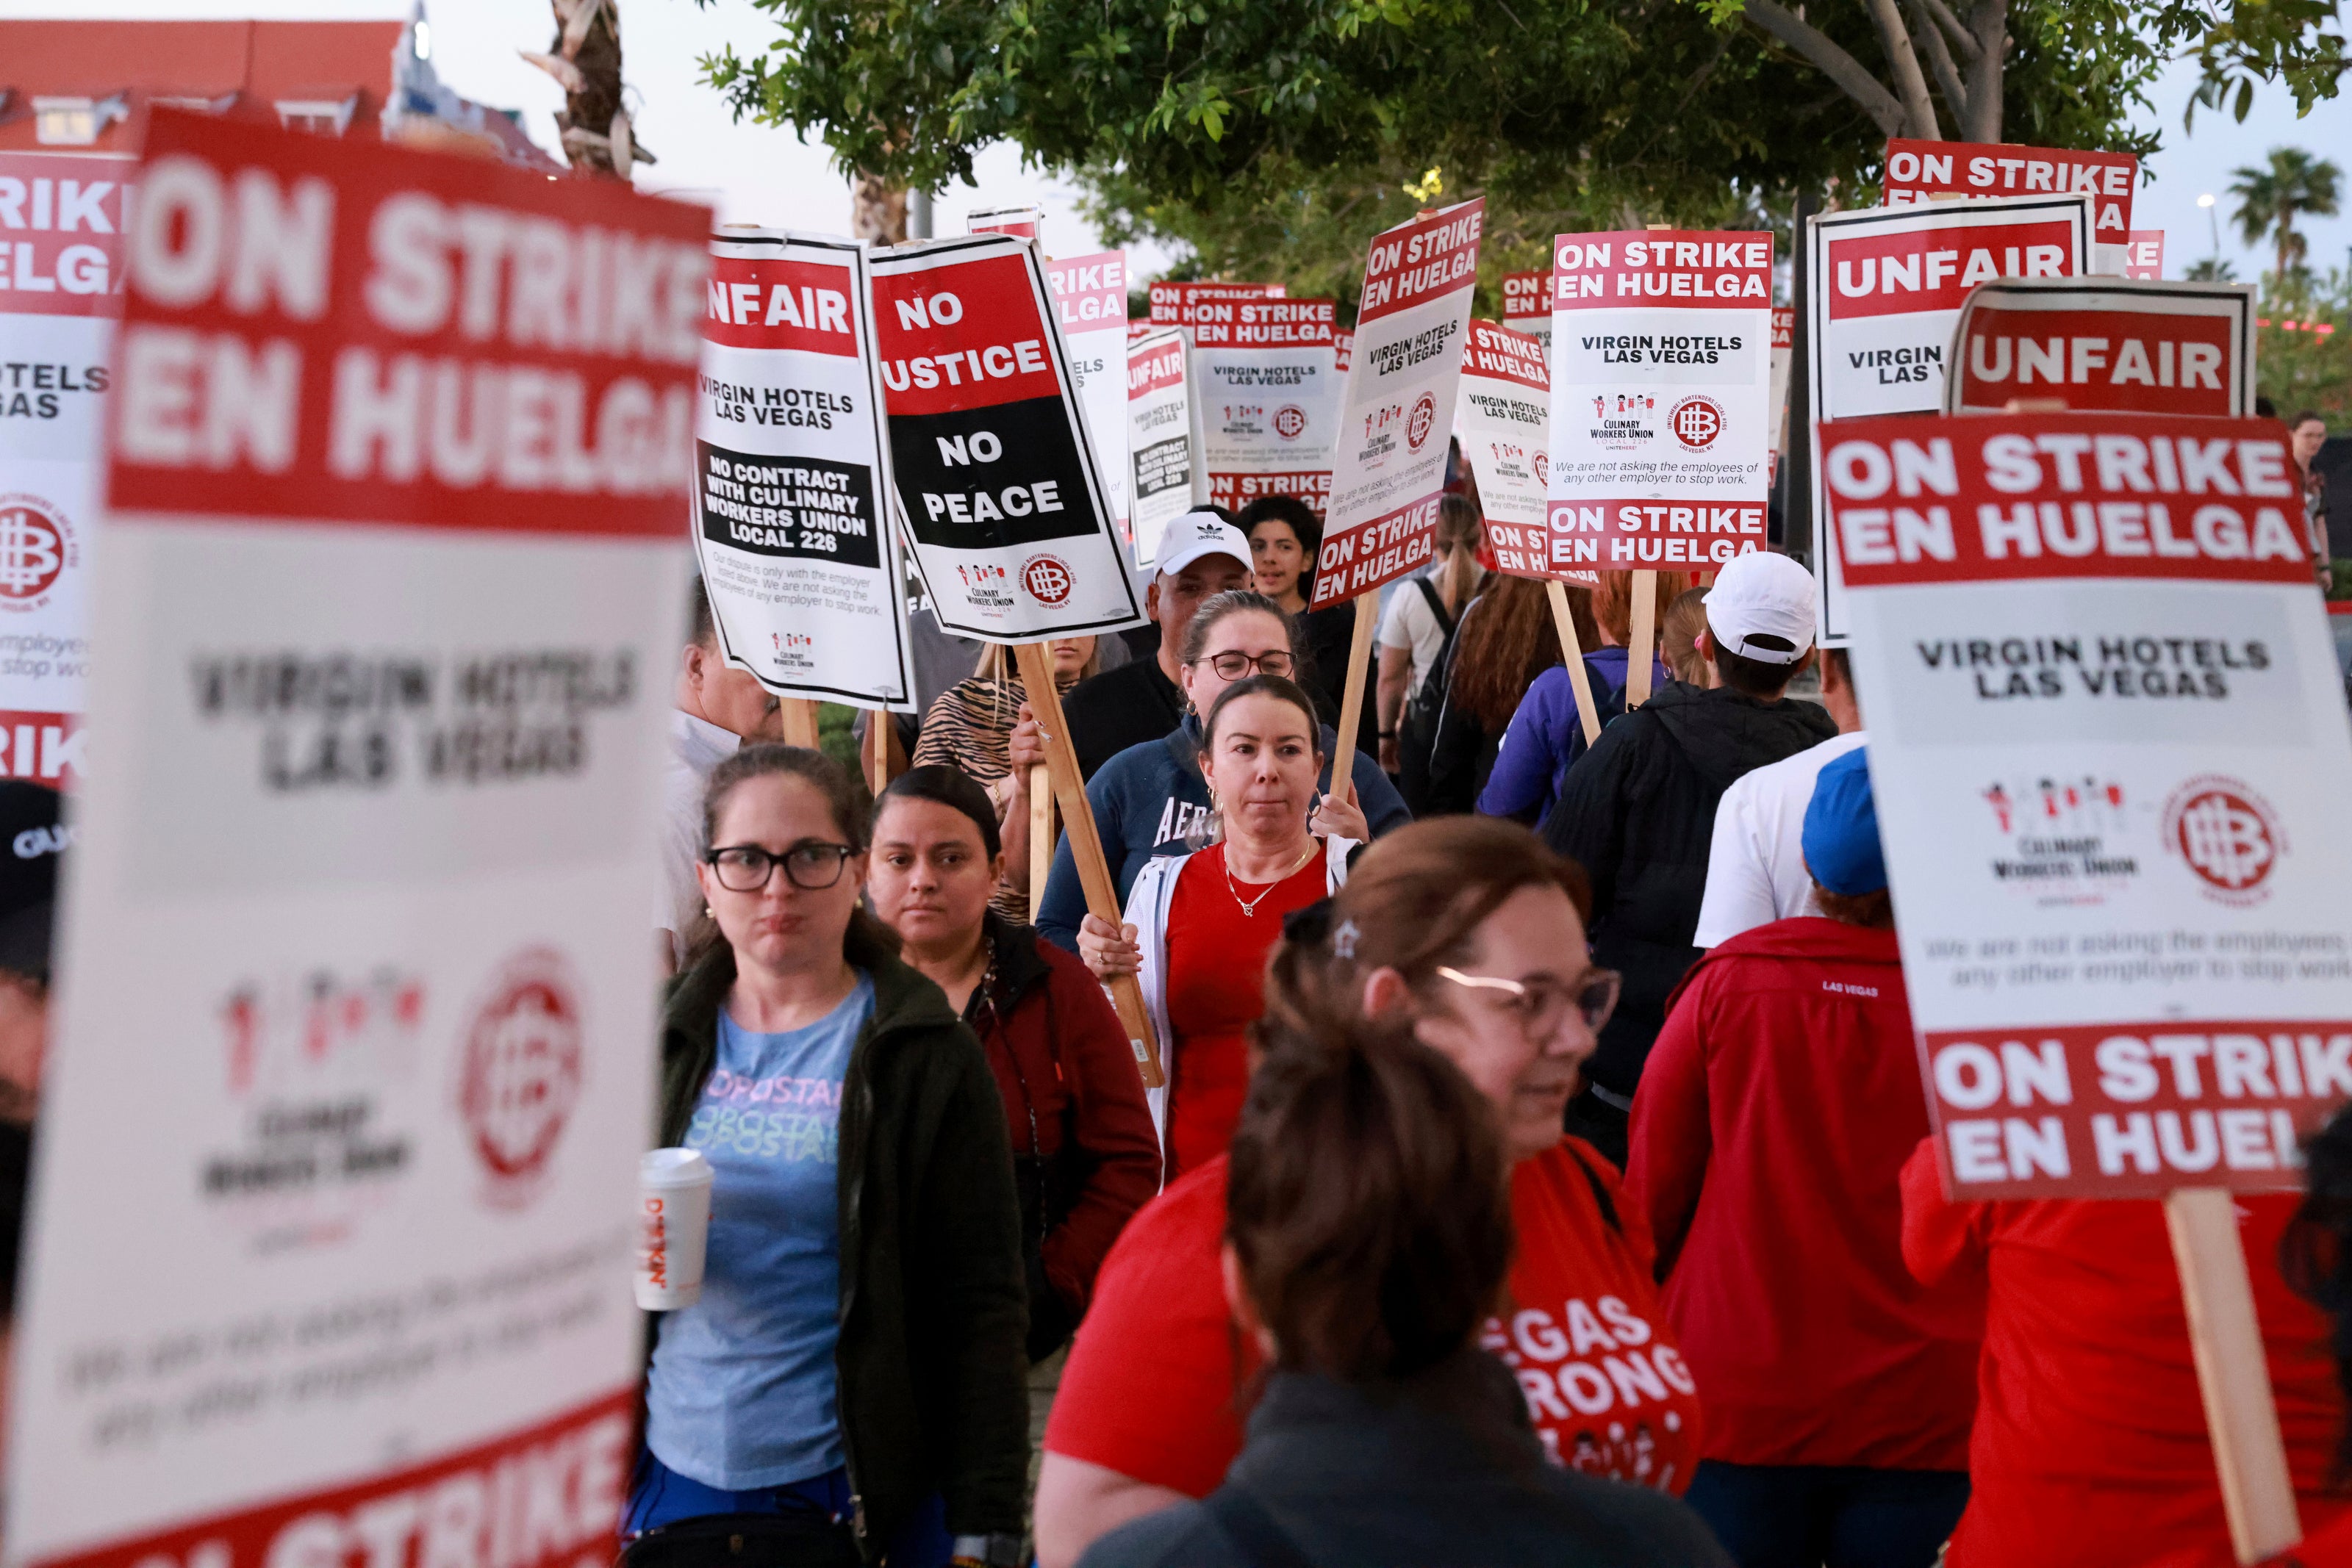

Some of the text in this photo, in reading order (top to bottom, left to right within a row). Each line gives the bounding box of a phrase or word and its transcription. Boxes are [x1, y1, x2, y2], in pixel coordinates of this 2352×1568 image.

[1888, 151, 2130, 196] ON STRIKE
[132, 154, 713, 363] ON STRIKE
[1369, 210, 1482, 276] ON STRIKE
[1557, 241, 1768, 270] ON STRIKE
[1048, 262, 1122, 295] RIKE
[1363, 247, 1476, 311] EN HUELGA
[1504, 277, 1538, 295] ON
[1557, 273, 1766, 299] EN HUELGA
[1838, 244, 2065, 298] UNFAIR
[707, 278, 850, 334] NFAIR
[894, 292, 963, 331] NO
[1150, 288, 1180, 304] ON
[1505, 296, 1535, 314] EN
[1152, 306, 1177, 321] EN
[1196, 304, 1333, 323] ON STRIKE
[1197, 323, 1332, 342] EN HUELGA
[1370, 320, 1458, 365] VIRGIN HOTELS
[1476, 328, 1544, 362] STRIKE
[1582, 336, 1742, 350] VIRGIN HOTELS
[881, 339, 1047, 392] USTICE
[1127, 351, 1182, 390] UNFAIR
[1214, 367, 1316, 375] VIRGIN HOTELS
[1379, 340, 1444, 377] LAS VEGAS
[1477, 350, 1549, 385] HUELGA
[1604, 350, 1719, 364] LAS VEGAS
[1849, 345, 1941, 370] VIRGIN
[1971, 334, 2222, 390] UNFAIR
[4, 363, 110, 392] TELS
[1228, 376, 1301, 385] LAS VEGAS
[1878, 365, 1928, 385] LAS
[118, 323, 300, 473] EN
[700, 374, 853, 414] VIRGIN HOTELS
[1469, 394, 1548, 418] VIRGIN HOTELS
[1681, 395, 1715, 403] BARTENDERS
[1714, 401, 1726, 417] LOCAL
[714, 399, 833, 430] LAS VEGAS
[1484, 406, 1541, 425] LAS VEGAS
[1604, 420, 1641, 429] CULINARY
[936, 431, 1003, 467] NO
[1591, 429, 1654, 439] WORKERS UNION
[1679, 443, 1688, 451] LAS
[709, 455, 850, 492] NO CONTRACT
[1556, 461, 1759, 475] We are not asking the employees of
[1564, 472, 1747, 486] any other employer to stop work.
[1826, 432, 2292, 501] ON STRIKE
[706, 474, 859, 514] WITH CULINARY
[1241, 475, 1331, 495] STRIKE
[705, 493, 867, 536] WORKERS UNION
[921, 480, 1064, 523] PEACE
[1320, 498, 1440, 571] ON STRIKE
[1550, 506, 1763, 533] ON STRIKE
[1839, 501, 2305, 566] EN HUELGA
[729, 521, 837, 553] LOCAL 226
[1491, 525, 1523, 547] ON
[1552, 539, 1597, 563] EN
[1313, 533, 1432, 603] EN HUELGA
[1496, 550, 1526, 570] EN
[972, 588, 999, 598] CULINARY
[993, 597, 1014, 606] UNION
[1918, 636, 2272, 671] VIRGIN HOTELS
[1976, 667, 2230, 700] LAS VEGAS
[1823, 981, 1878, 997] LAS VEGAS
[1933, 1034, 2352, 1110] ON STRIK
[1946, 1115, 2072, 1184] EN
